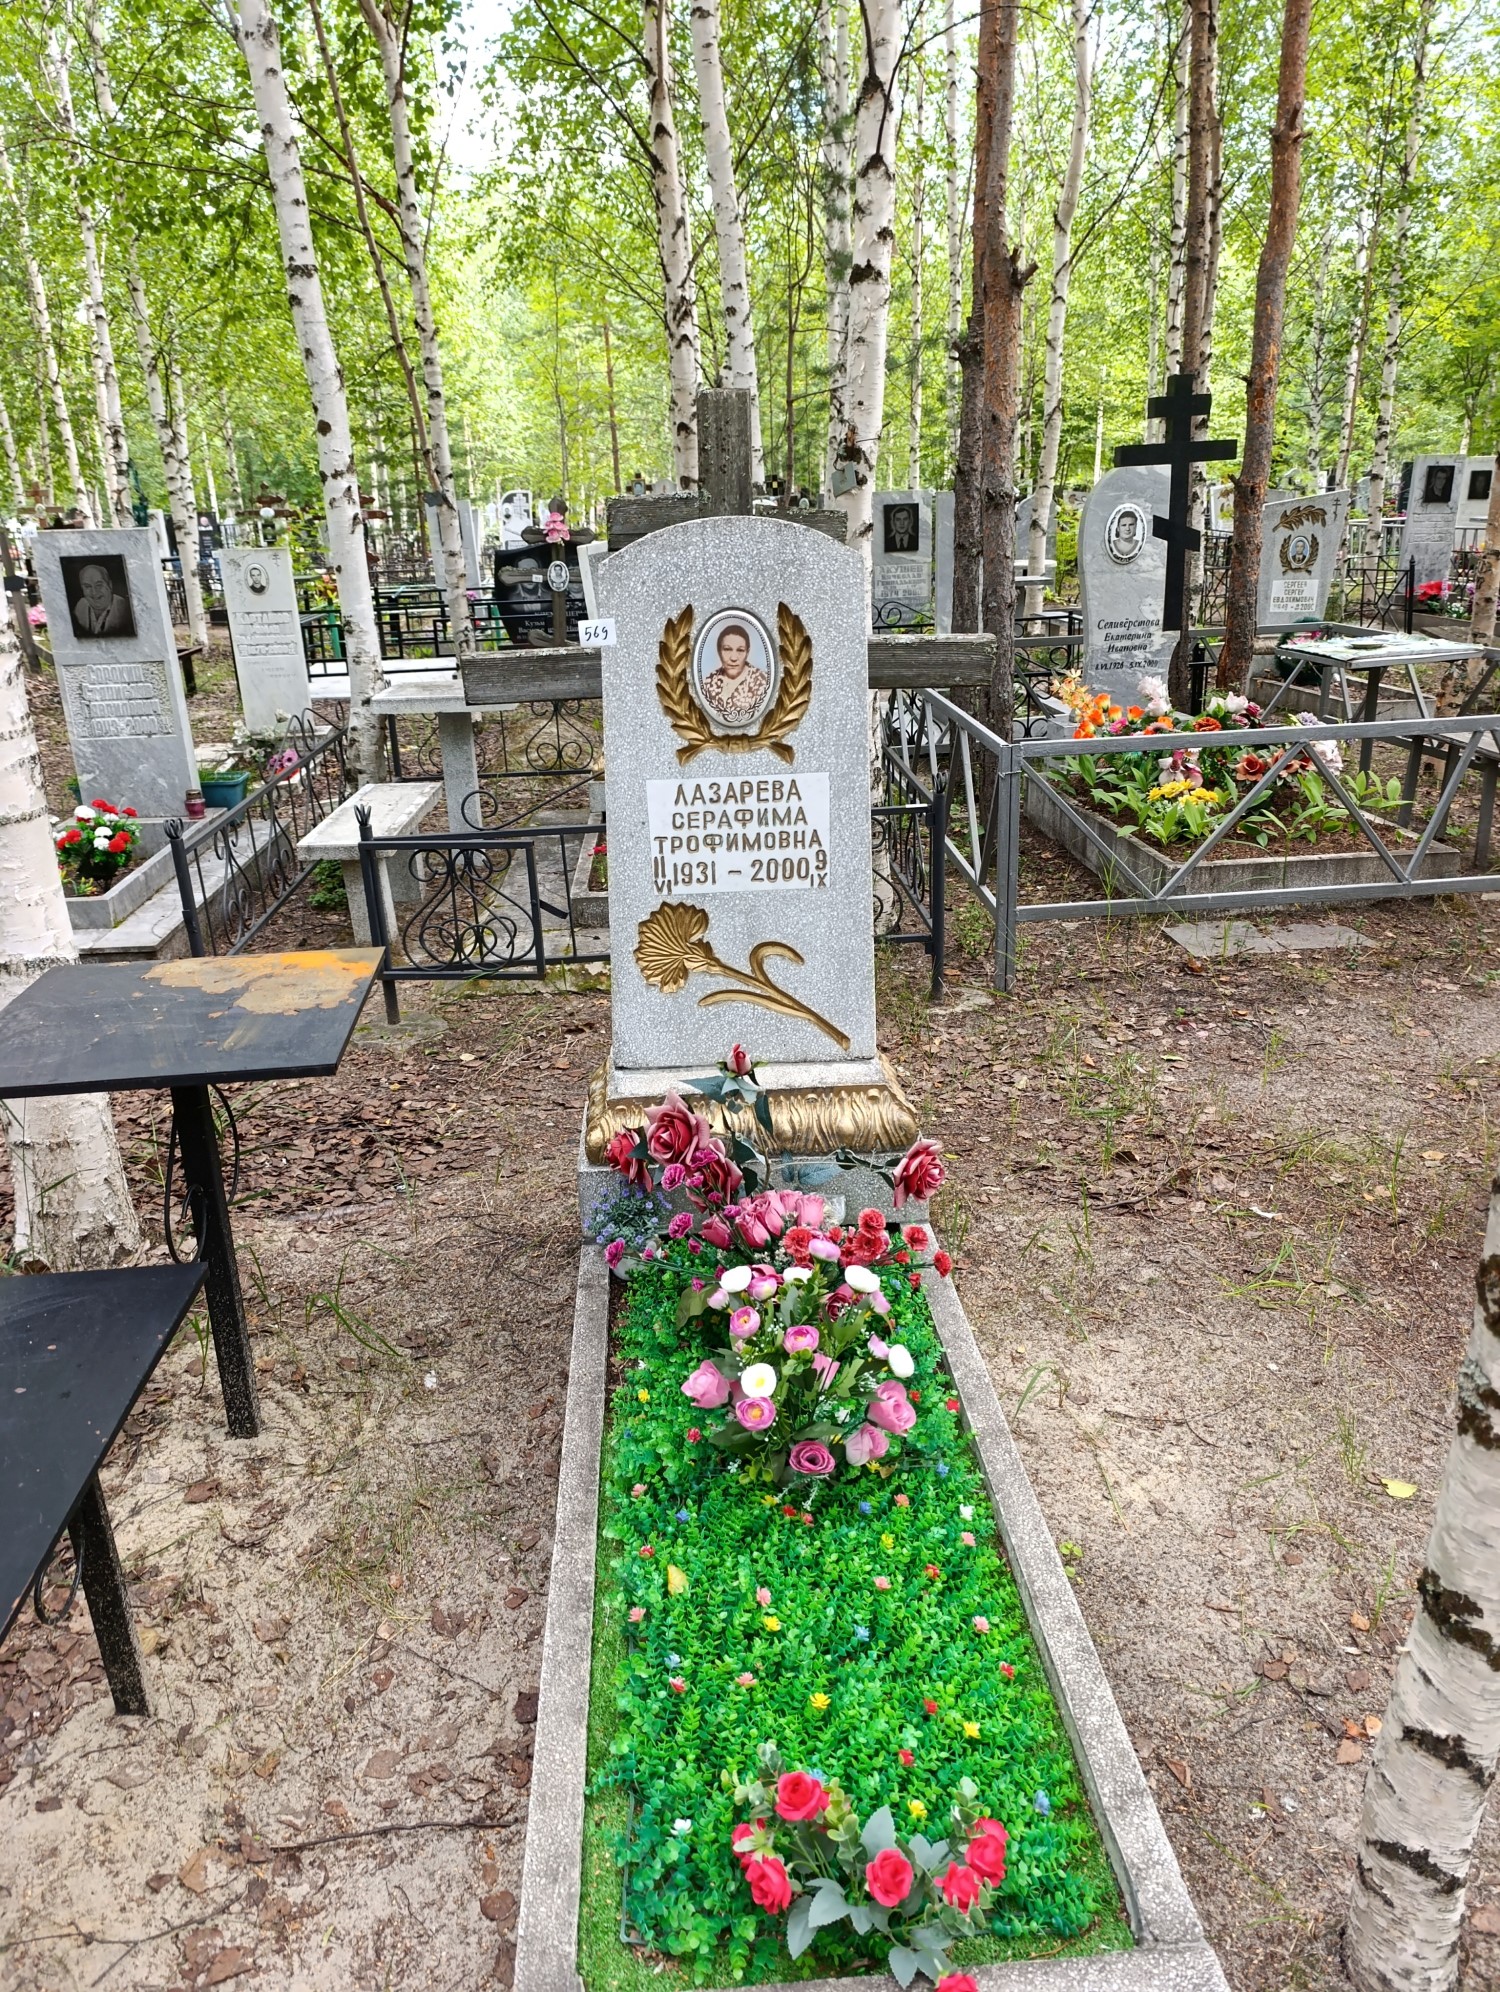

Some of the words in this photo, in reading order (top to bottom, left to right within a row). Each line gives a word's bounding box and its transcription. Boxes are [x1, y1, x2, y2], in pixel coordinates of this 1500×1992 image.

[584, 625, 609, 642] 569
[1097, 618, 1160, 631] Селивёрстова
[1104, 632, 1152, 642] Екатерина
[1107, 644, 1148, 653] Ивановна
[86, 664, 145, 682] СОРОКИН
[674, 778, 802, 807] ЛАЗАРЕВА
[671, 806, 809, 830] СЕРАФИМА
[653, 829, 823, 855] ТРОФИМОВНА
[673, 860, 717, 887] 1931
[750, 856, 810, 883] 2000
